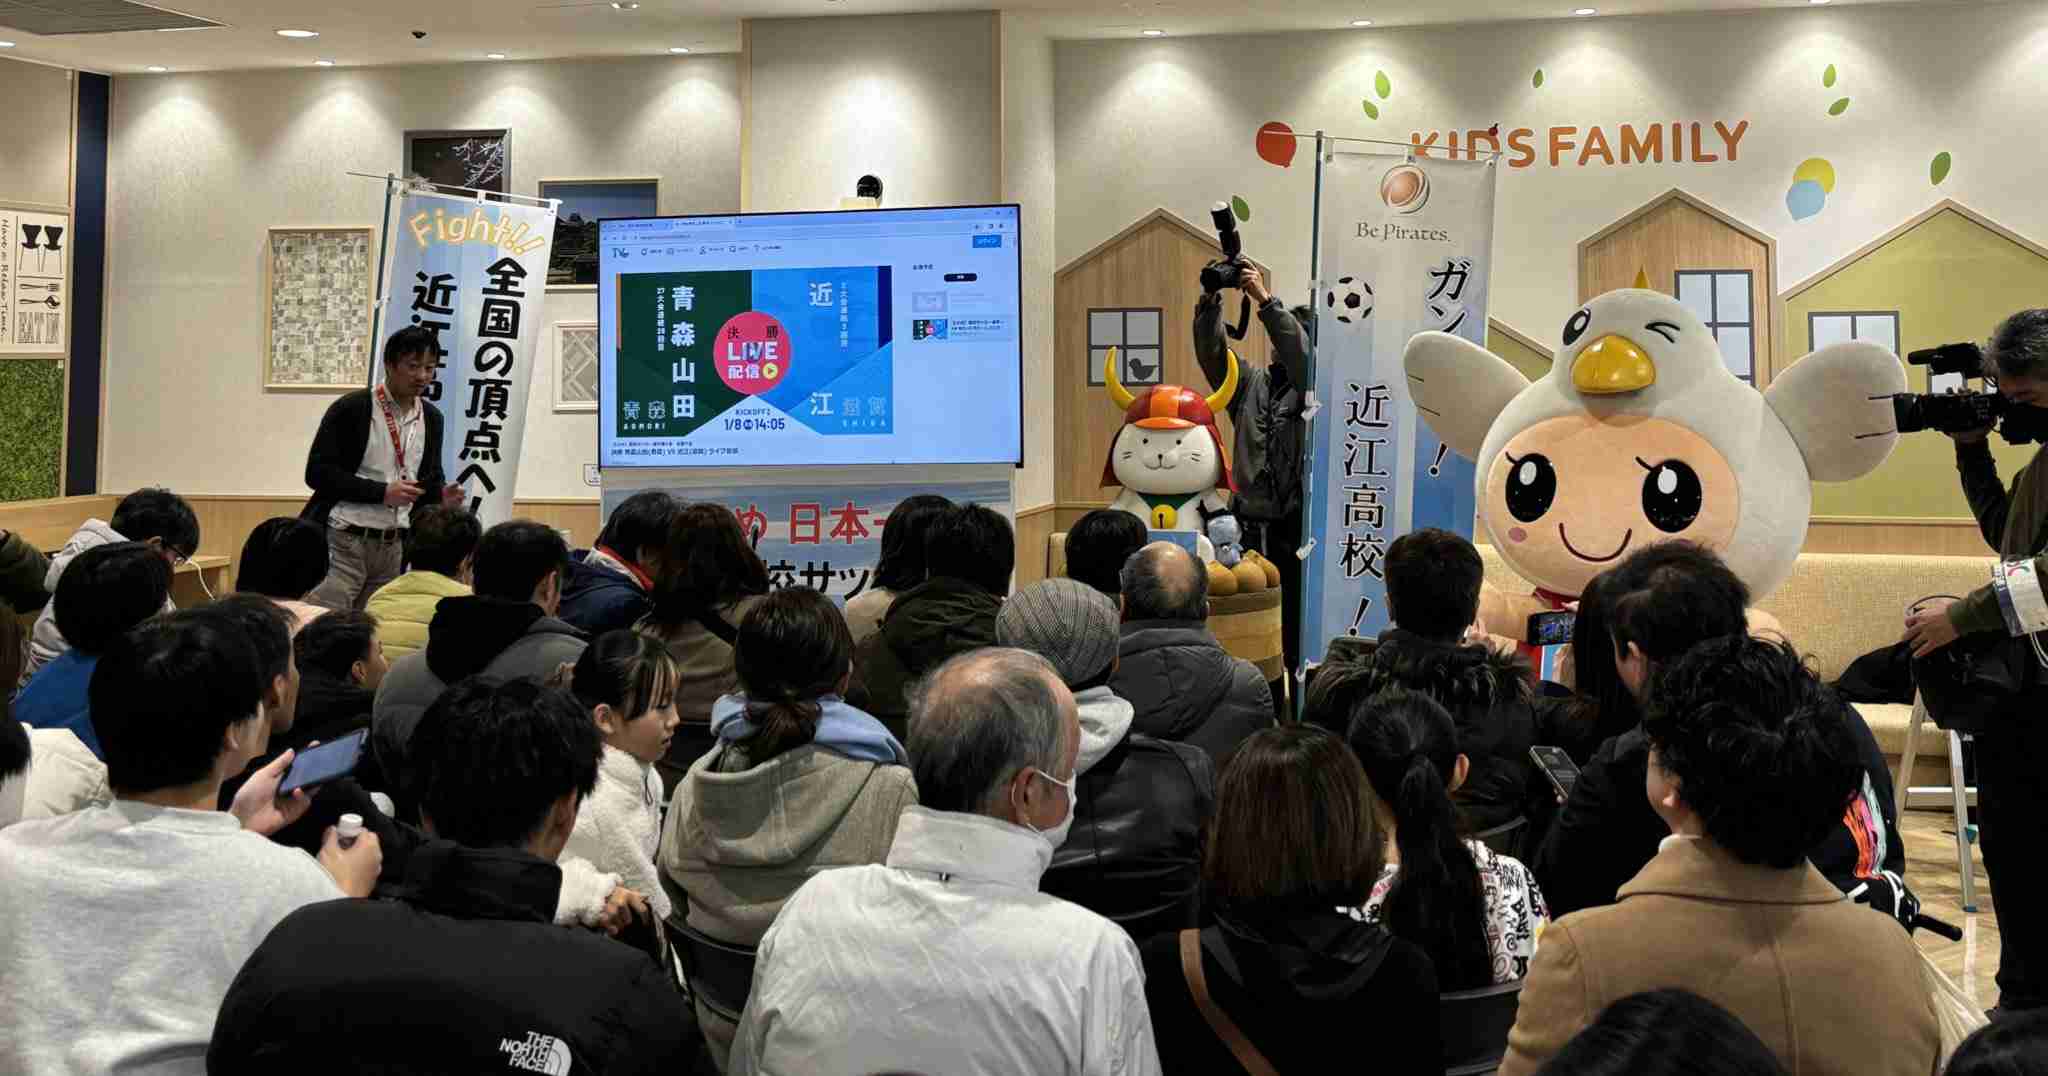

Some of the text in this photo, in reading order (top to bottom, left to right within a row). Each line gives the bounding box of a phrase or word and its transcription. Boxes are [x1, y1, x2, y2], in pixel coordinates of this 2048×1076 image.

[1410, 120, 1749, 168] KIDS FAMILY
[407, 207, 545, 256] Fight!!
[1354, 222, 1379, 238] Be
[671, 286, 696, 418] 青森山田
[727, 341, 778, 361] LIVE
[1339, 383, 1392, 637] 近江高校!
[499, 1038, 550, 1062] NORTH
[527, 1031, 554, 1048] THE
[508, 1052, 546, 1072] FACE
